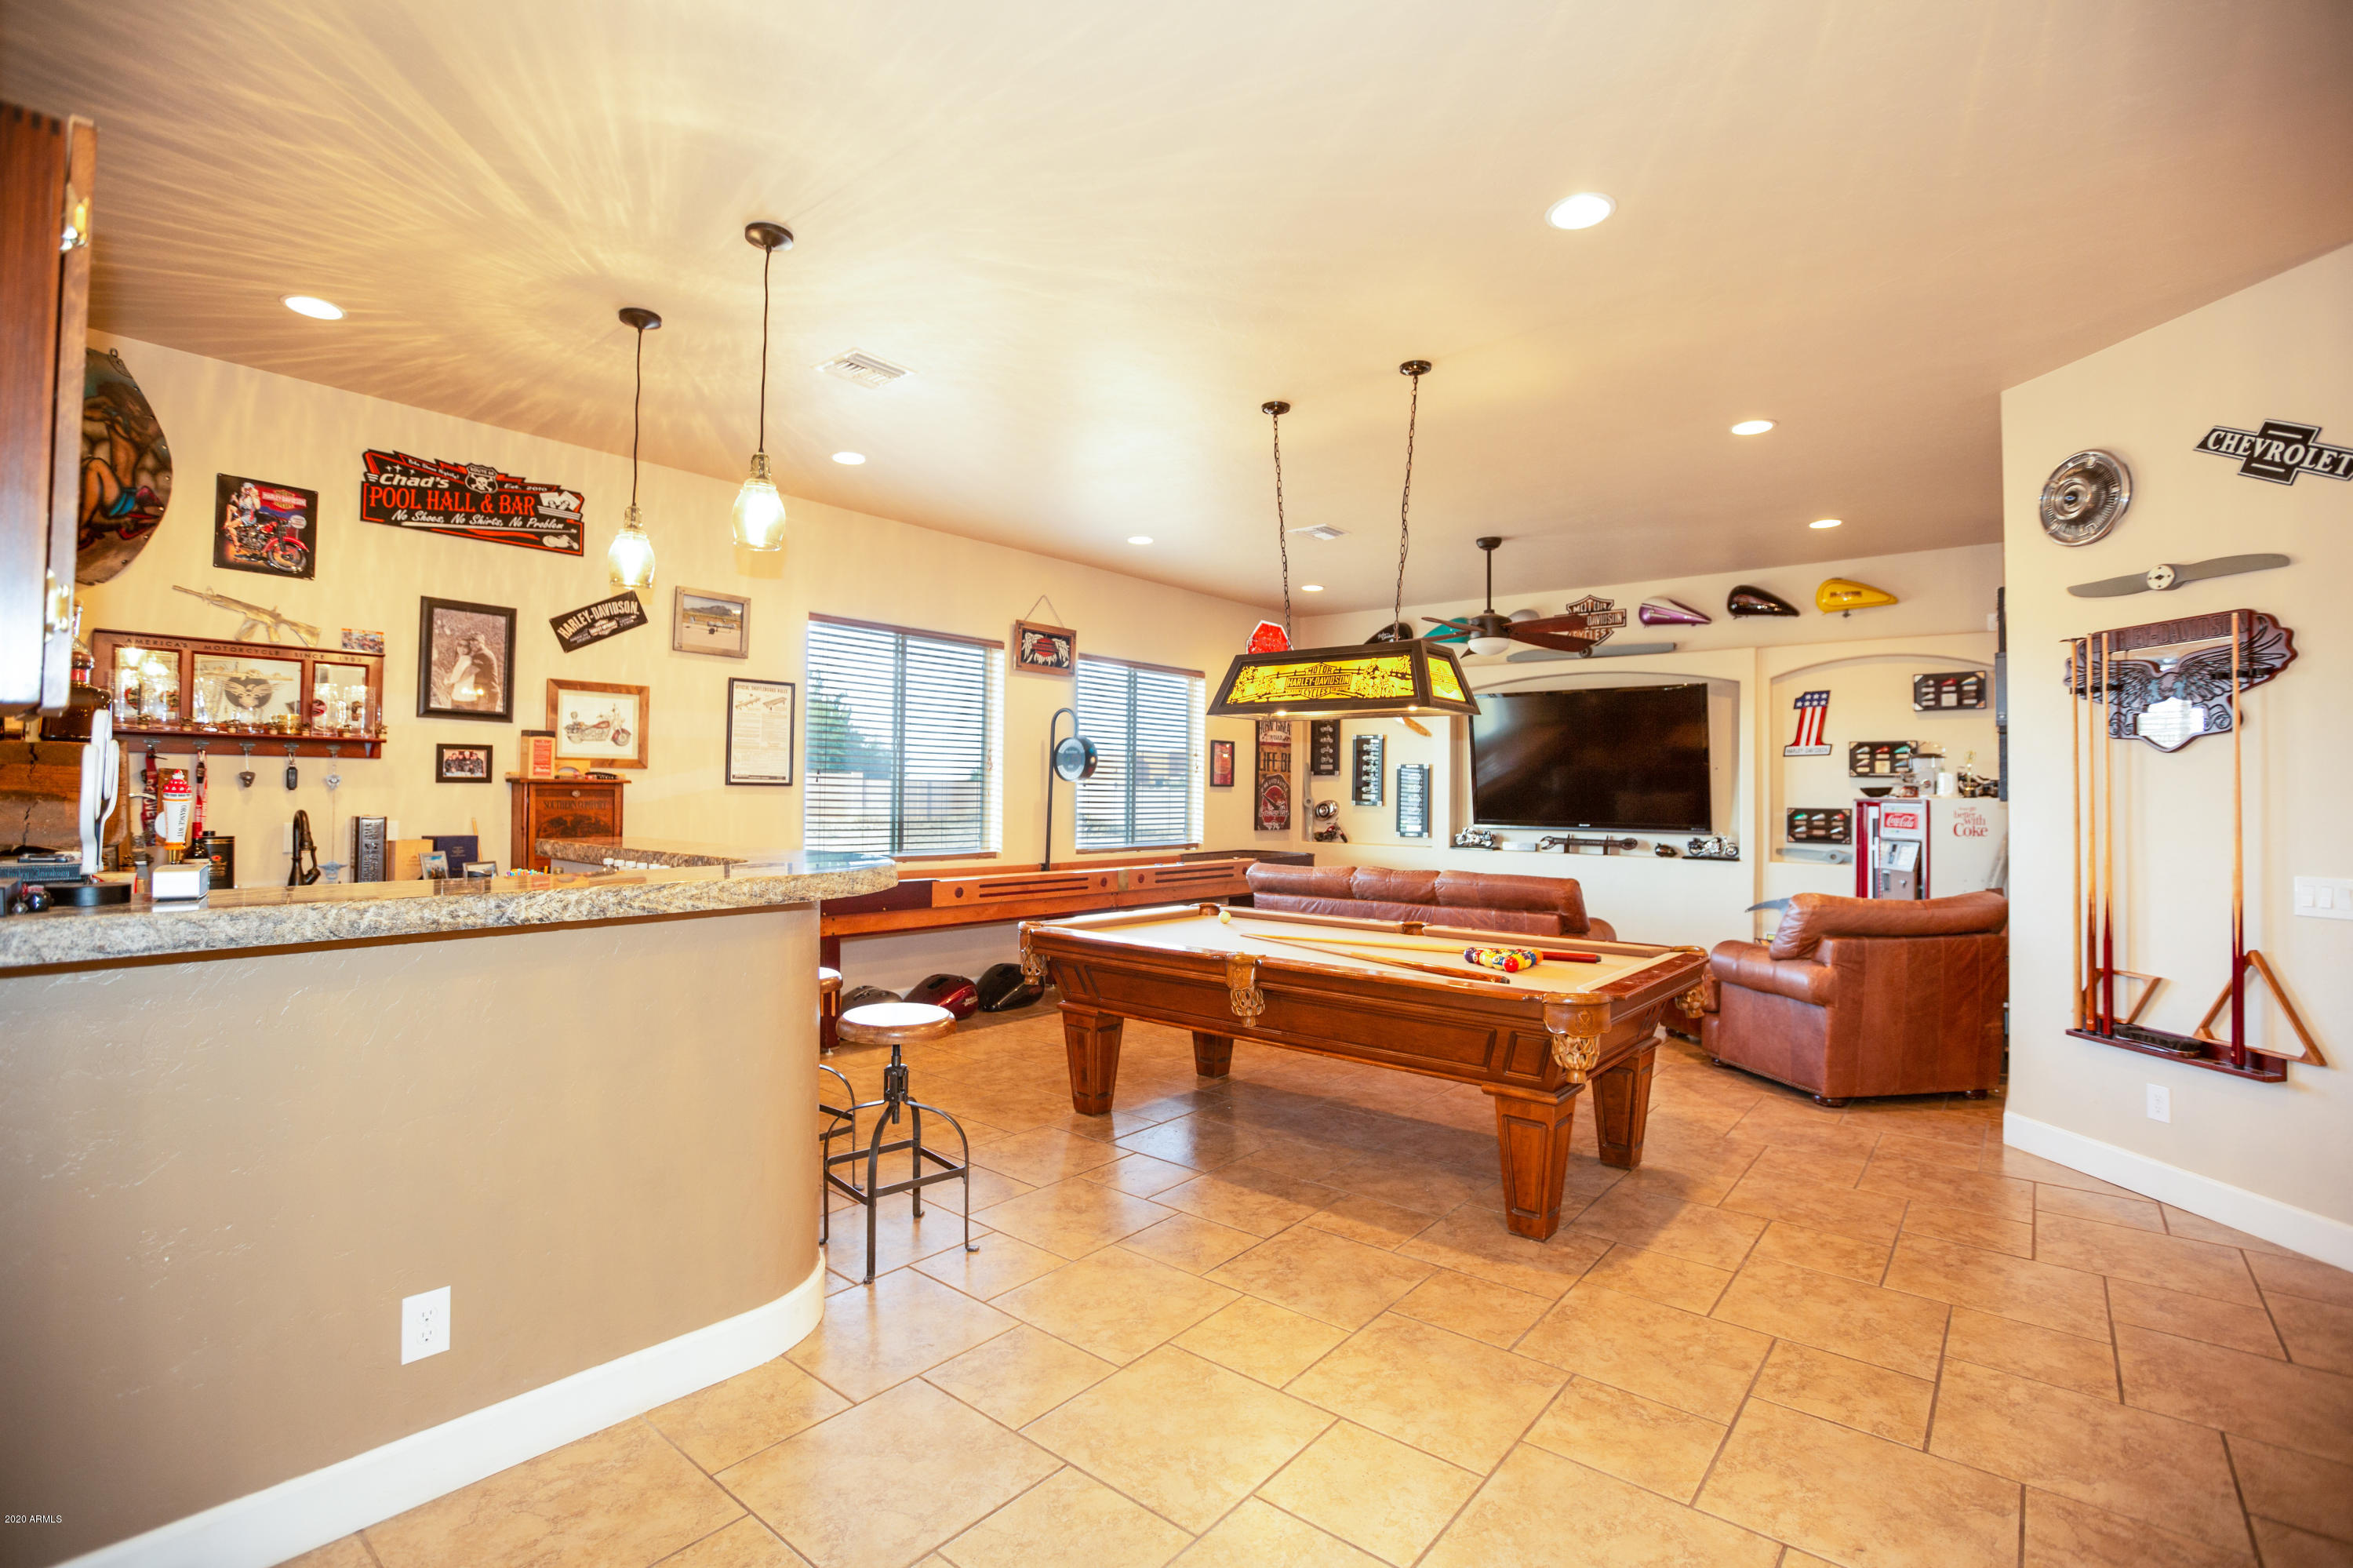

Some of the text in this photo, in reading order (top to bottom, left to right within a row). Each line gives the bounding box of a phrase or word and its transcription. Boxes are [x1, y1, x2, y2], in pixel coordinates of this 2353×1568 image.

[2206, 430, 2353, 475] CHEVROLET
[379, 473, 450, 489] Chad's
[369, 486, 536, 517] POOL HALL & BAR
[391, 509, 408, 521] No
[450, 513, 466, 524] No
[508, 516, 523, 527] No
[526, 518, 564, 529] Problem
[1573, 598, 1607, 613] MOTOR
[557, 600, 639, 640] HARLEY-DAVIDSON
[1587, 613, 1623, 626] DAVIDSON
[125, 638, 188, 648] AMERICA'S
[204, 645, 281, 657] MOTORCYCLE
[294, 652, 325, 660] SINCE
[1307, 664, 1333, 674] MOTOR
[1287, 675, 1350, 687] HARLEY-DAVIDSON
[1303, 687, 1329, 698] CYCLES
[178, 805, 187, 827] ORANGE
[1953, 823, 1989, 837] Coke
